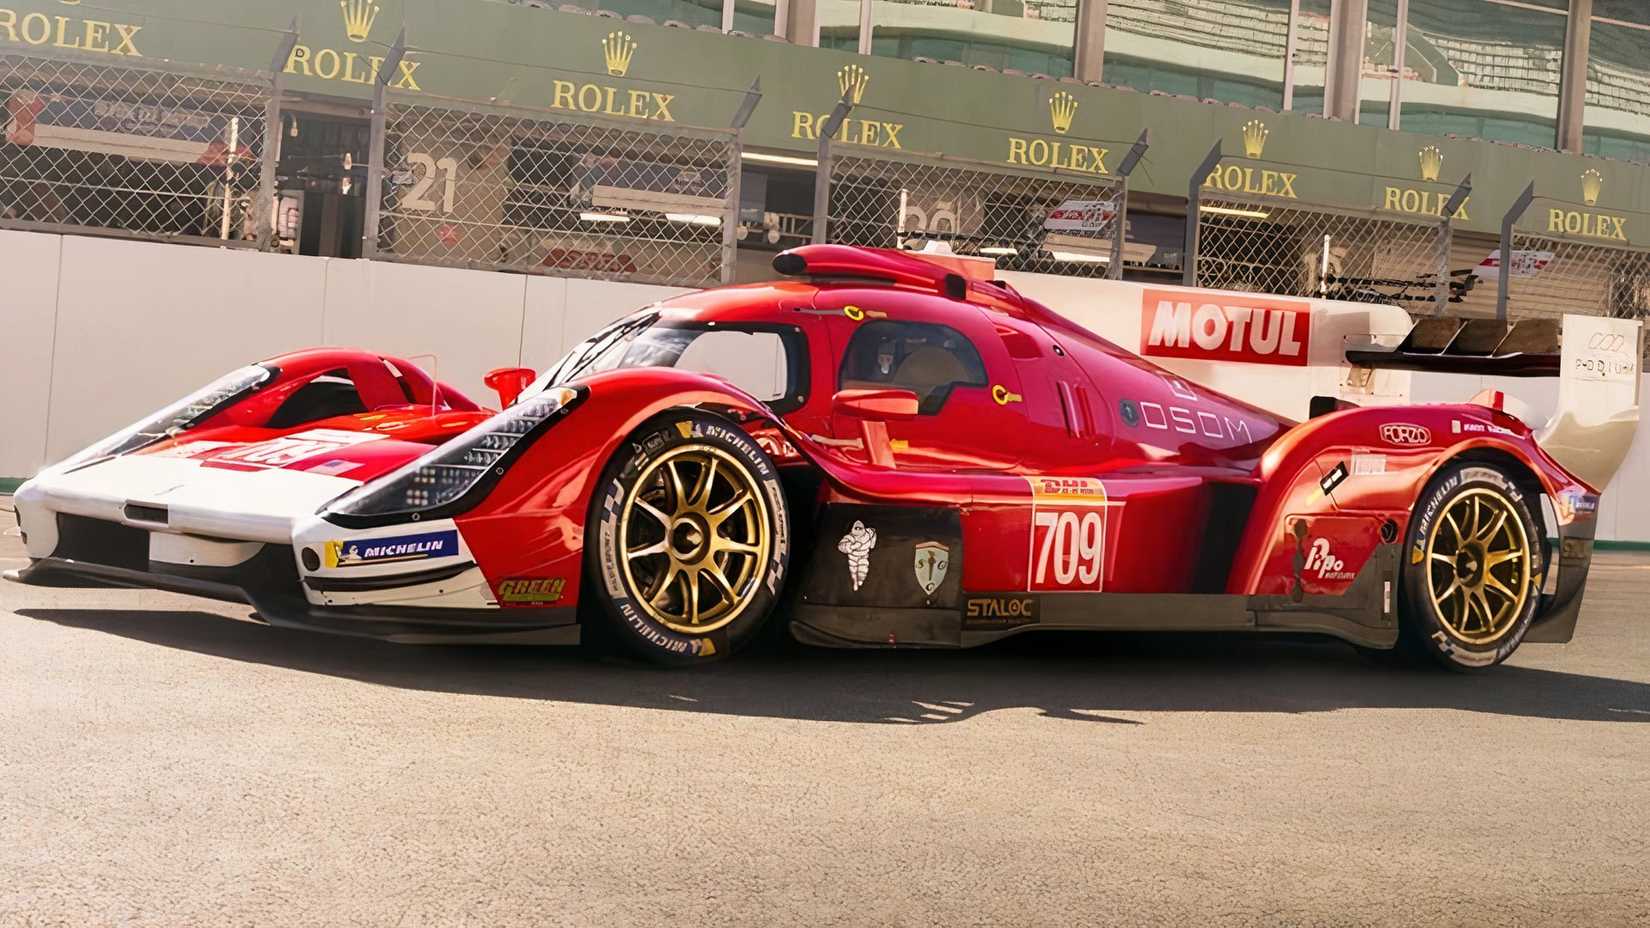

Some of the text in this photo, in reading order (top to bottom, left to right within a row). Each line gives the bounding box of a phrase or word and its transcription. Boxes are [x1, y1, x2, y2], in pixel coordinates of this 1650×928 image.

[551, 80, 675, 122] ROLEX
[1007, 137, 1109, 174] ROLEX
[400, 153, 457, 211] 21
[1203, 164, 1297, 198] ROLEX
[1549, 208, 1627, 241] ROLEX
[1148, 301, 1302, 357] MOTUL
[1140, 402, 1253, 443] OSOM
[706, 425, 769, 475] MICHELIN
[364, 540, 443, 557] MICHELIN
[1034, 512, 1103, 585] 709
[967, 599, 1032, 616] STALOC
[620, 603, 688, 654] MICHELIN
